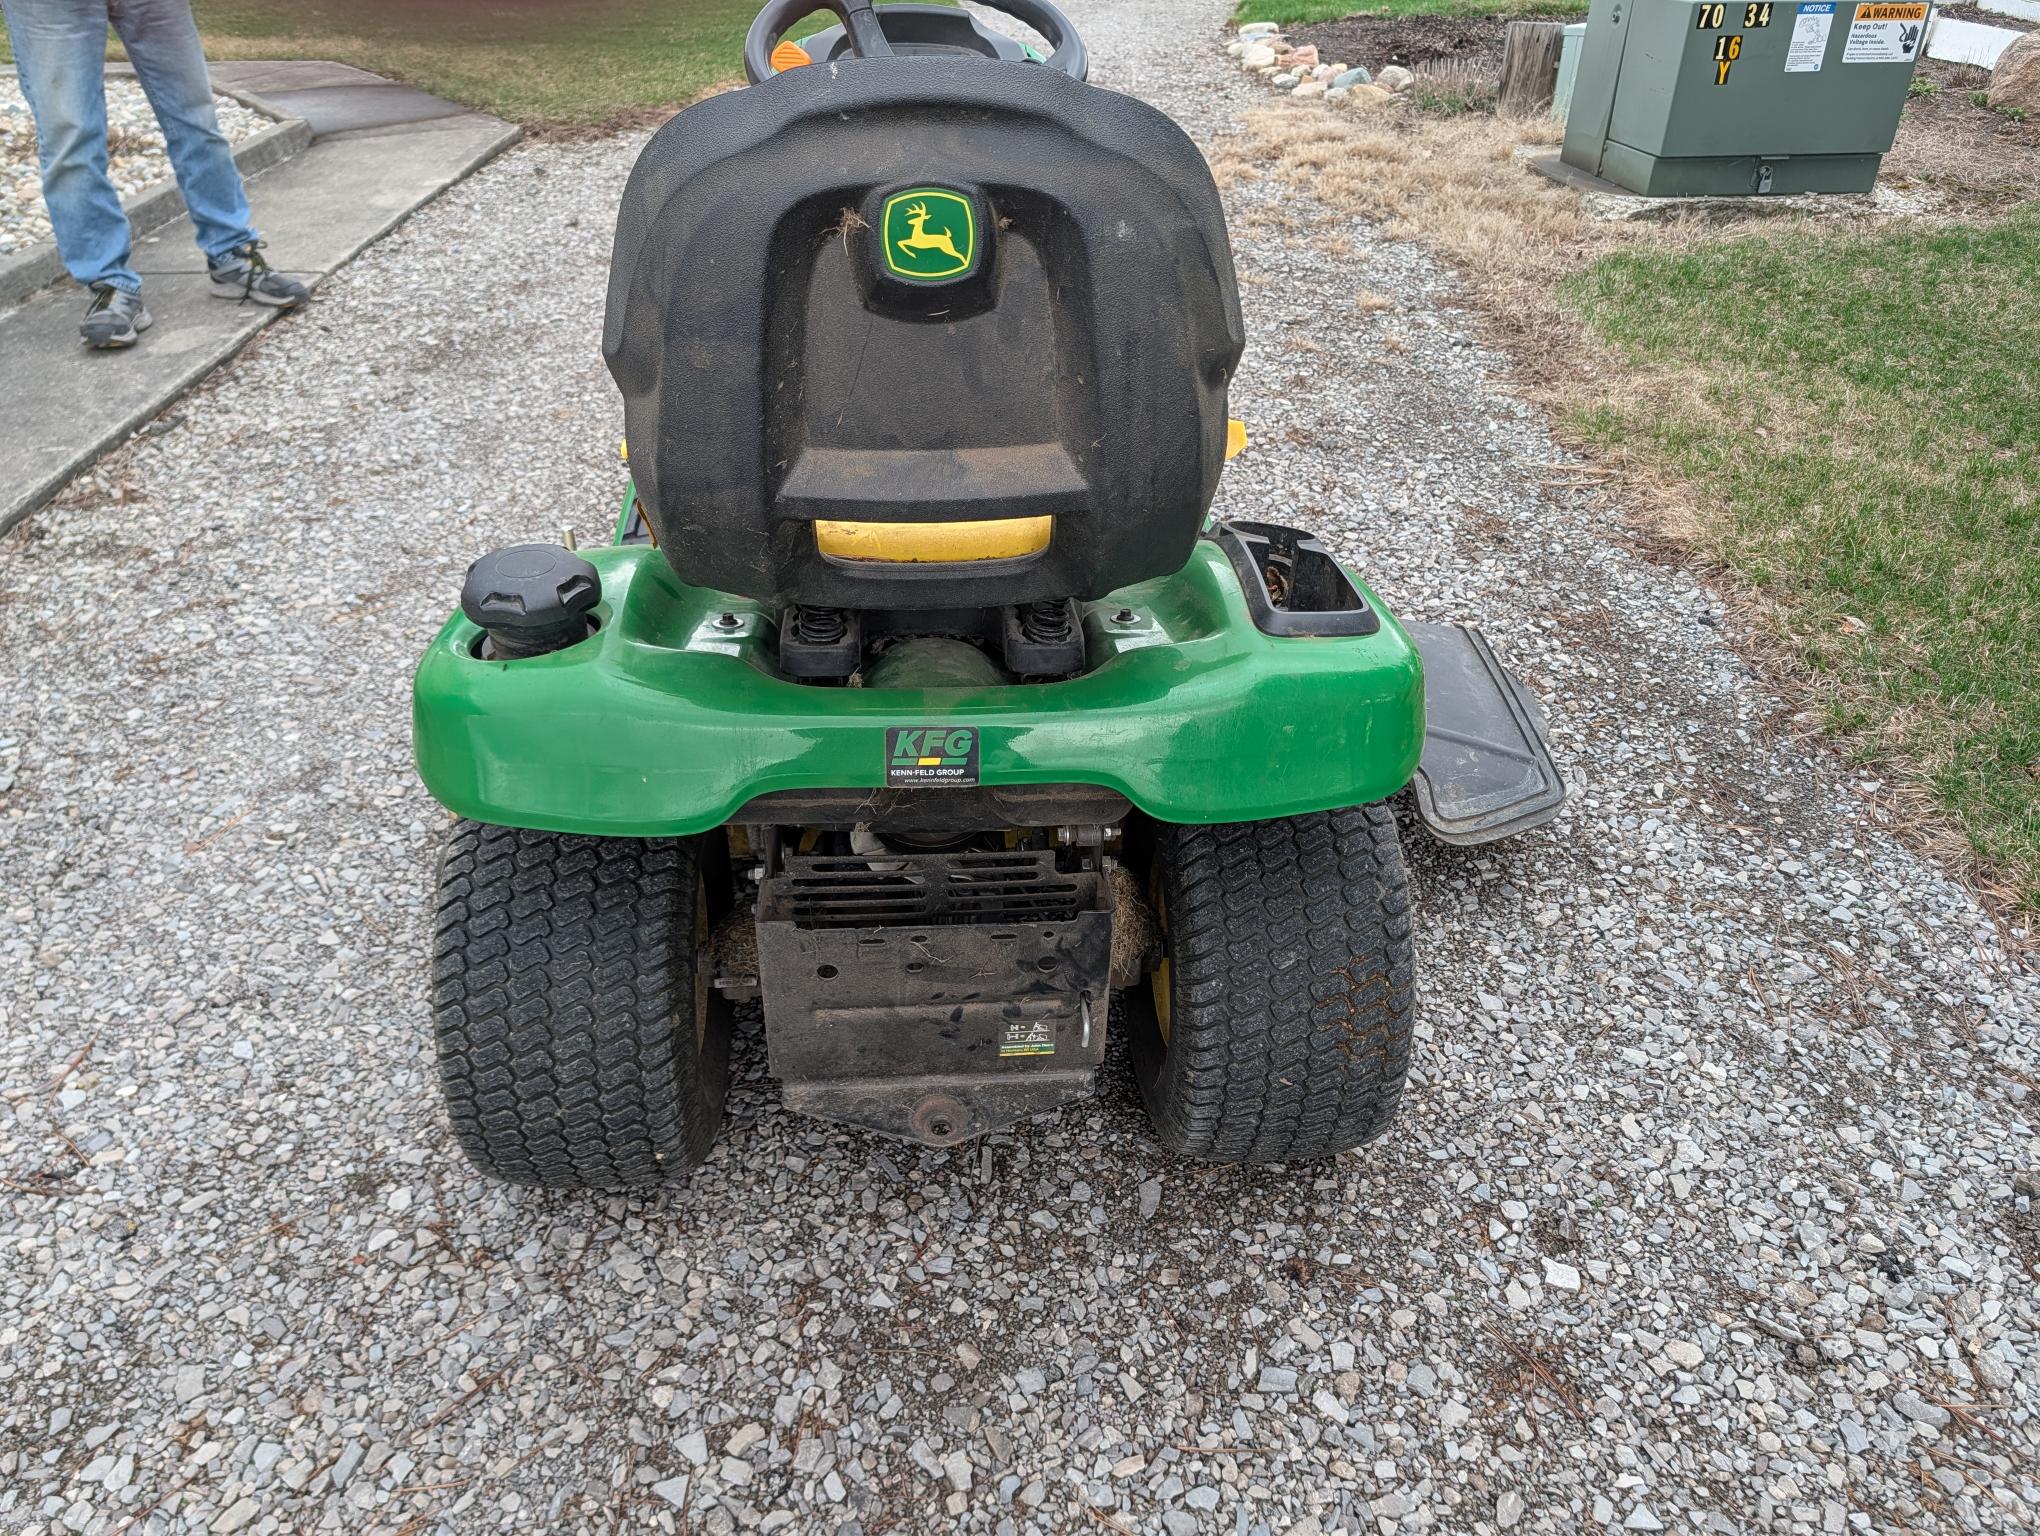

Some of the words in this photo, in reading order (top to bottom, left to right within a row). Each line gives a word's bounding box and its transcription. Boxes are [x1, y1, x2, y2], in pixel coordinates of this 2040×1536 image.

[1699, 4, 1724, 28] 70
[1744, 3, 1770, 27] 34
[1802, 4, 1832, 12] NOTICE
[1873, 7, 1922, 19] WARNING
[1853, 23, 1871, 31] Keep
[1715, 36, 1741, 60] 16
[1718, 61, 1731, 85] Y
[893, 730, 973, 757] KFG
[936, 768, 965, 776] GROUP
